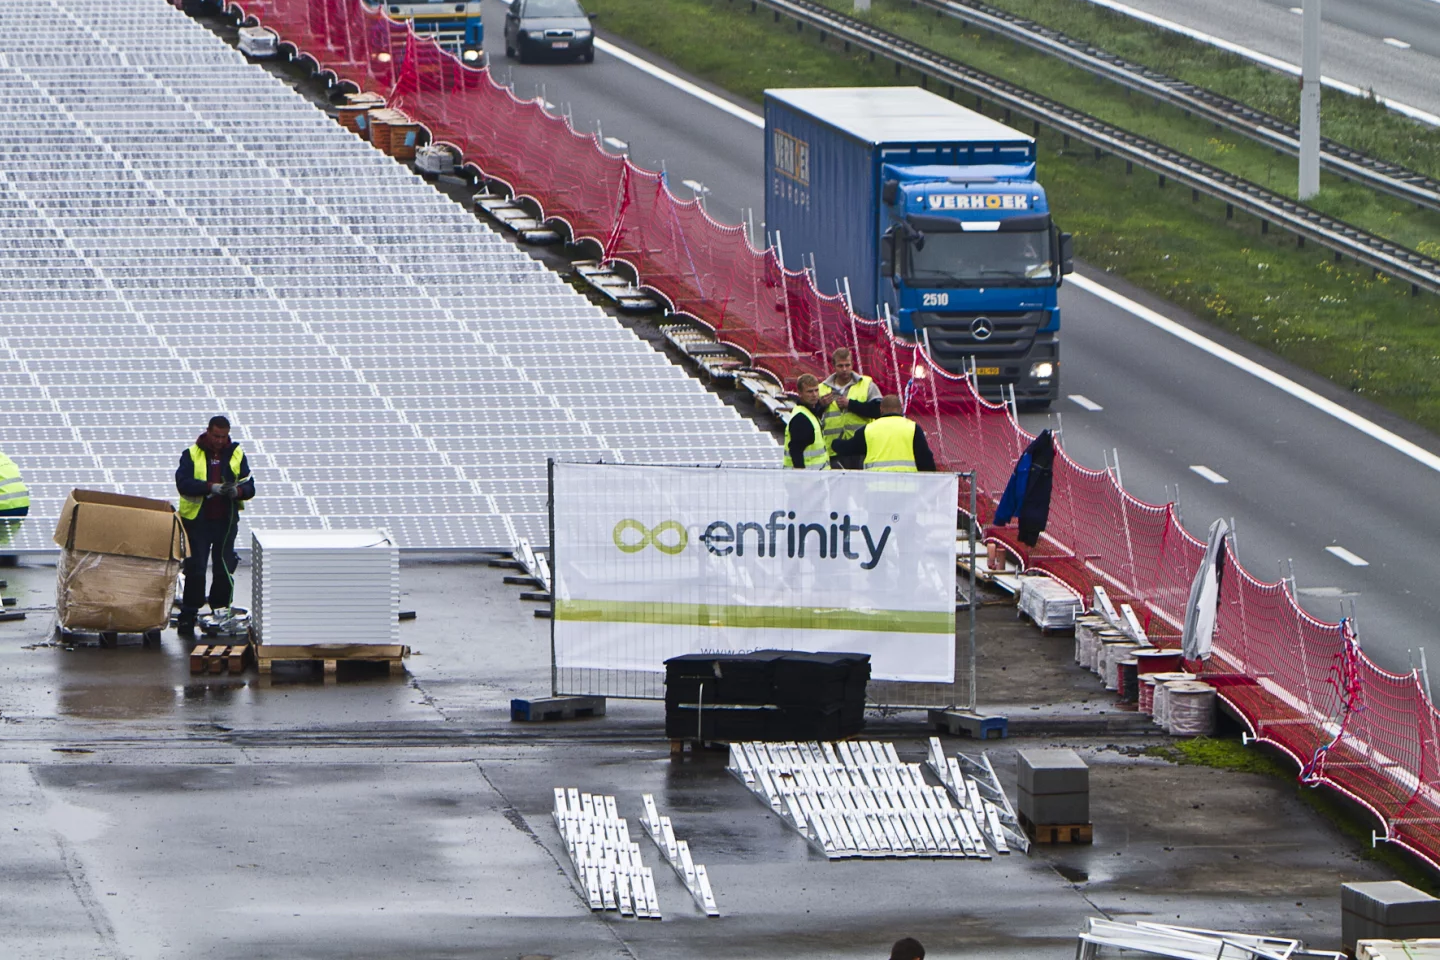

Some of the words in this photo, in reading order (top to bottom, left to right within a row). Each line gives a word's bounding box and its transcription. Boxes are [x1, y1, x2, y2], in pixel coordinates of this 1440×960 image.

[928, 194, 1028, 210] VERHOEK
[923, 293, 949, 307] 2510
[700, 510, 892, 570] enfinity
